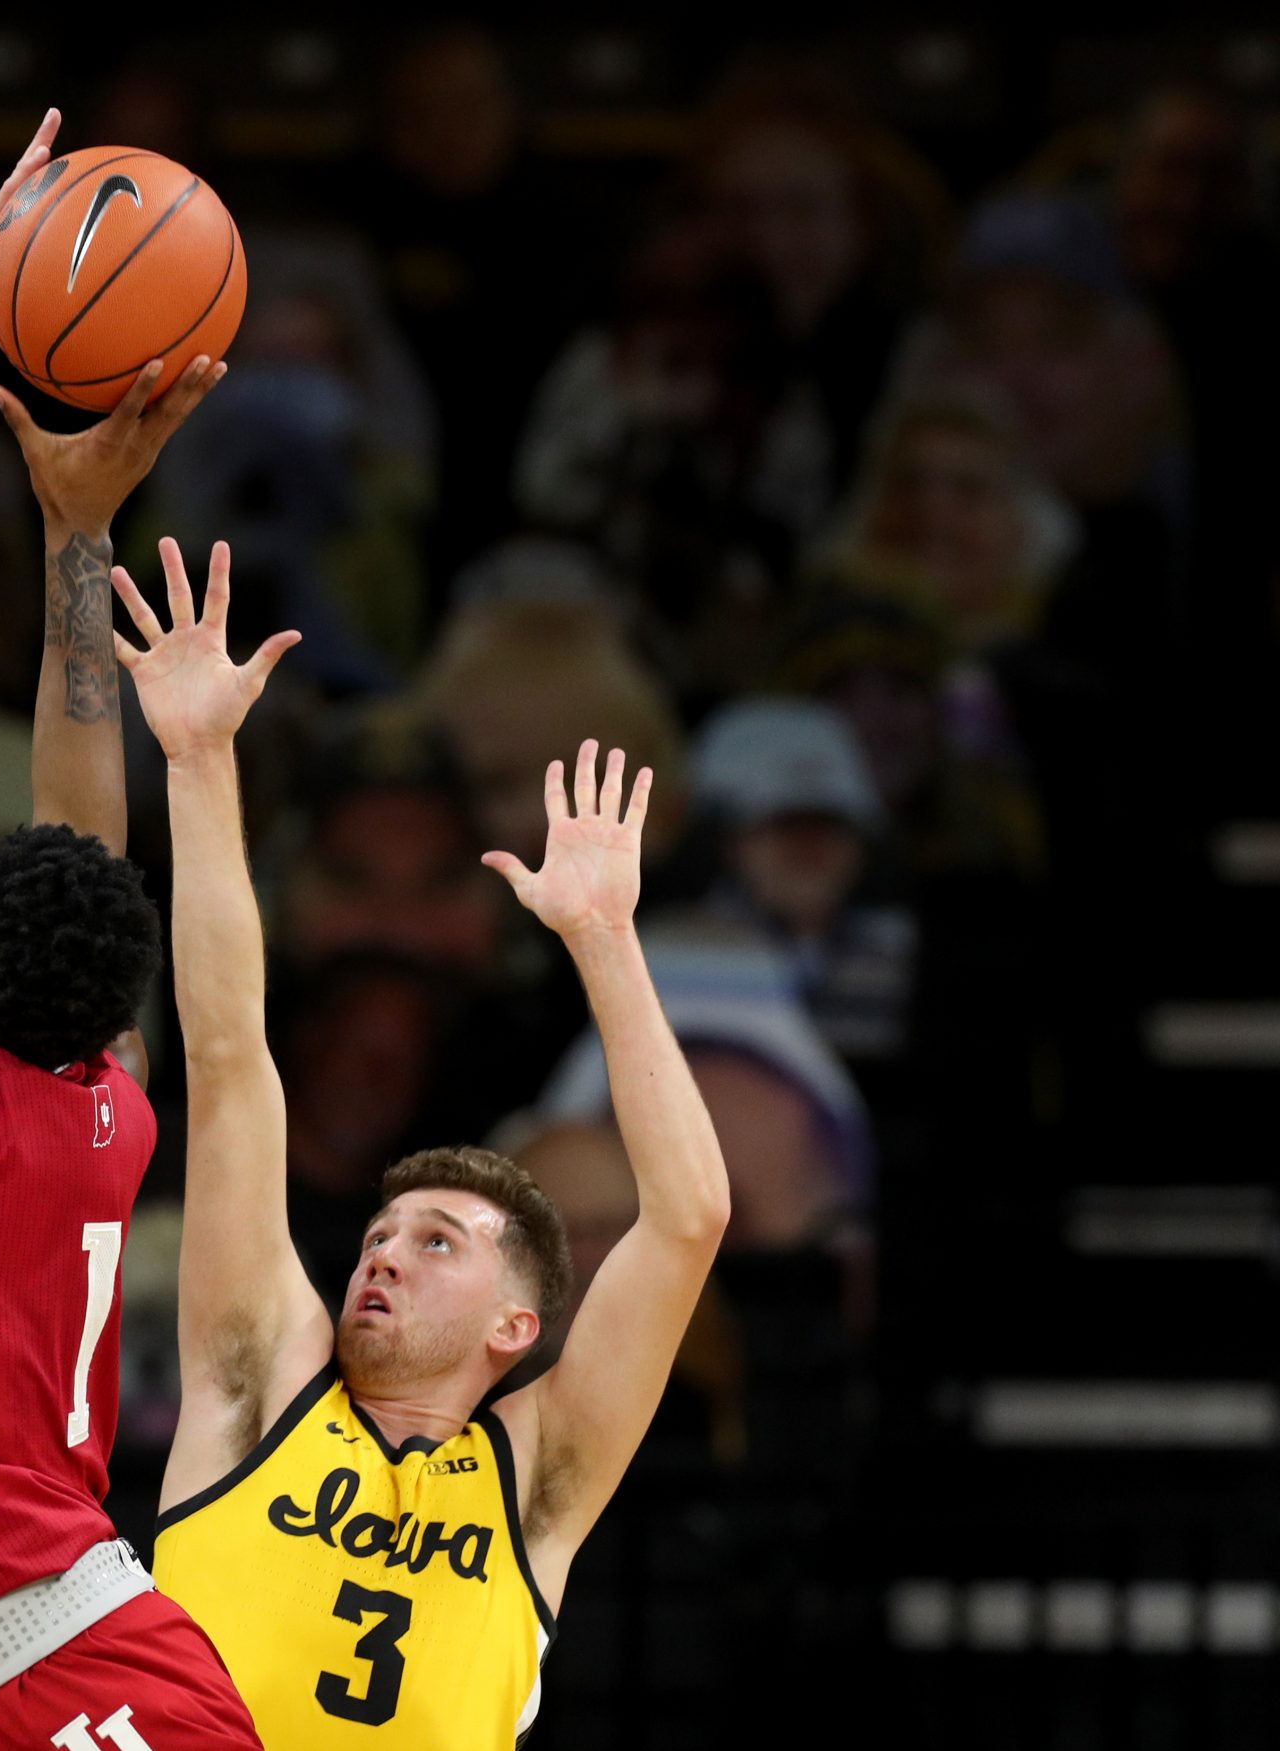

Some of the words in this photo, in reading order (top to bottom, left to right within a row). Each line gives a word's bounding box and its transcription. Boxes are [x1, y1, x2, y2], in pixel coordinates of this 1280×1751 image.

[67, 1221, 122, 1448] 1
[268, 1467, 493, 1583] Iowa
[315, 1580, 412, 1726] 3
